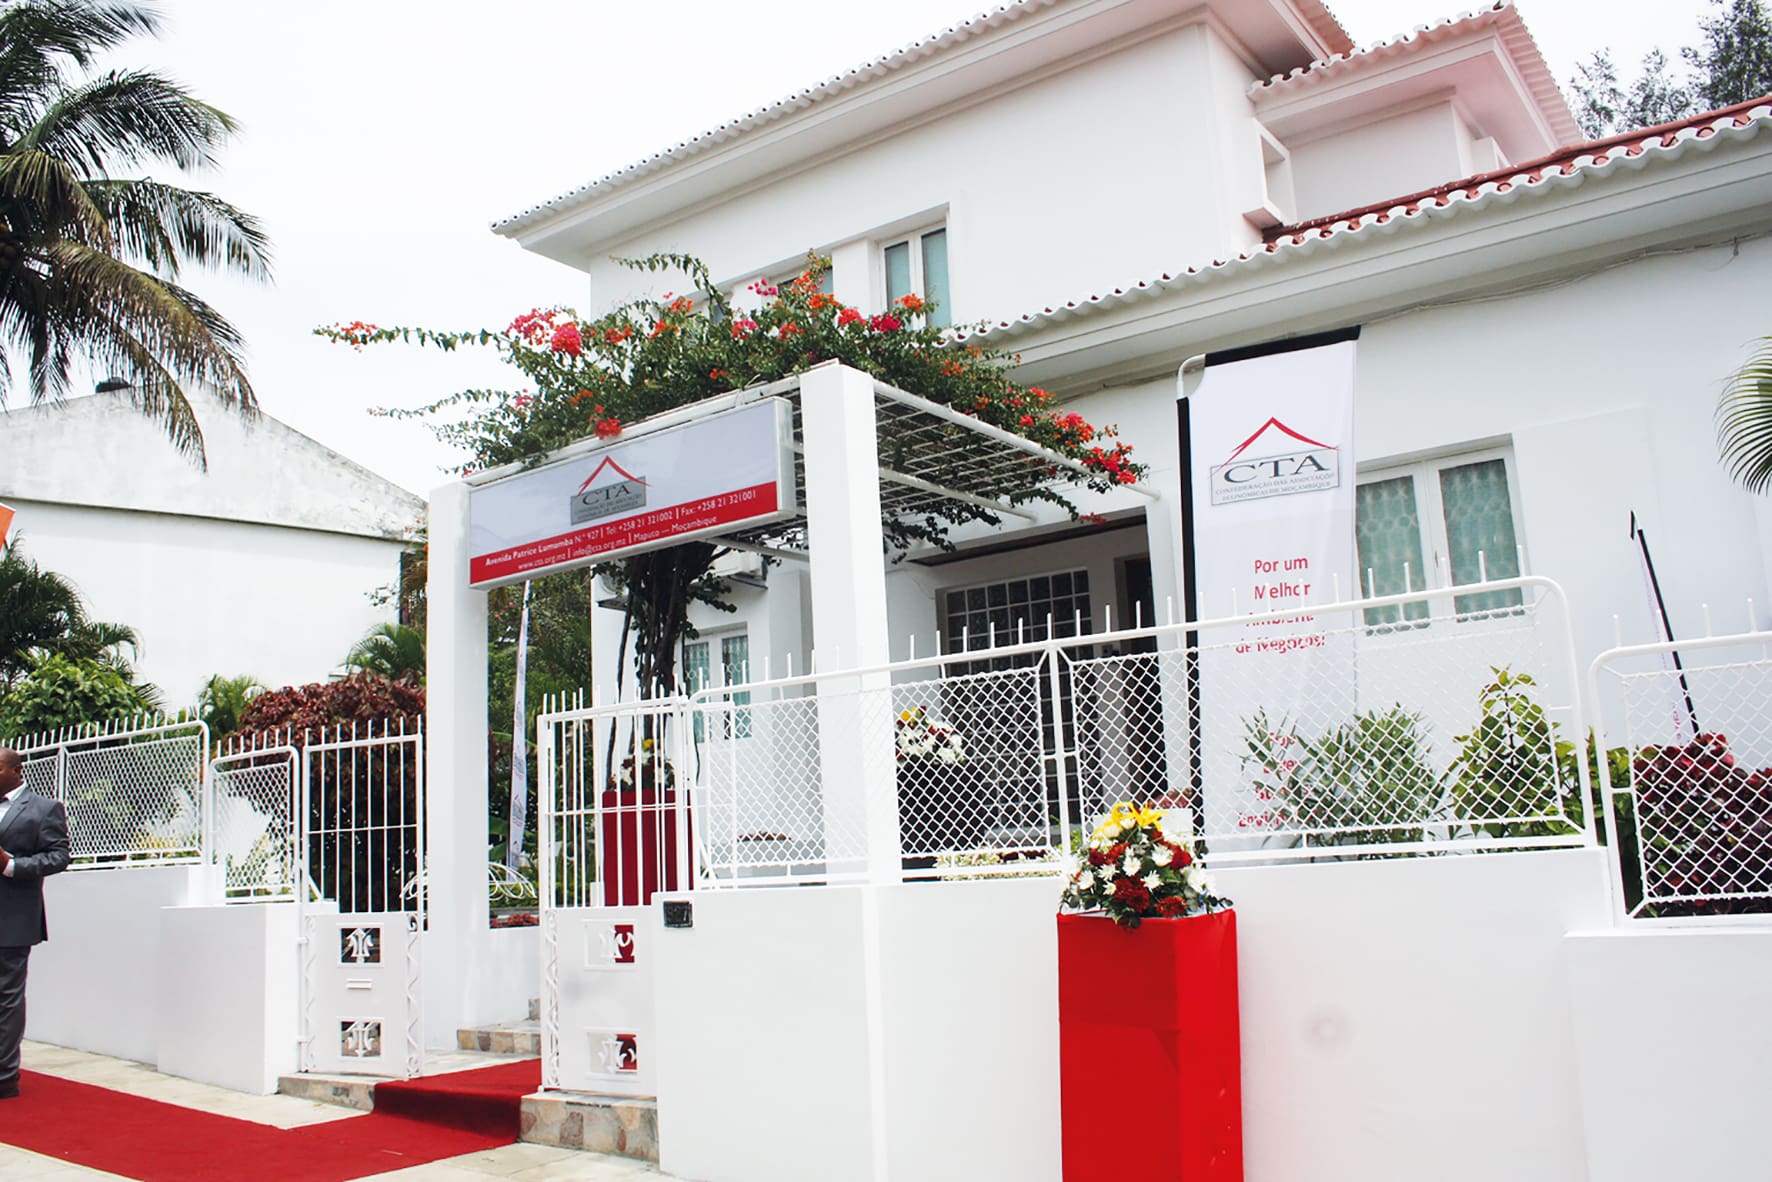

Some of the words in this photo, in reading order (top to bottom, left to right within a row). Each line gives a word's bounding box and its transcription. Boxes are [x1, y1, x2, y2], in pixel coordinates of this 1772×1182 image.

[1224, 454, 1331, 483] CTA
[582, 484, 631, 505] CTA
[485, 553, 512, 566] Avenida
[513, 548, 537, 559] Patrice
[538, 538, 573, 553] Lumumba
[619, 521, 635, 532] +258
[637, 518, 645, 528] 21
[647, 512, 673, 525] 321002
[681, 506, 696, 517] Fax:
[697, 499, 716, 512] +258
[717, 497, 726, 507] 21
[729, 490, 756, 504] 321001
[671, 516, 718, 532] Moçambique
[1254, 559, 1279, 574] Por
[1284, 557, 1309, 570] um
